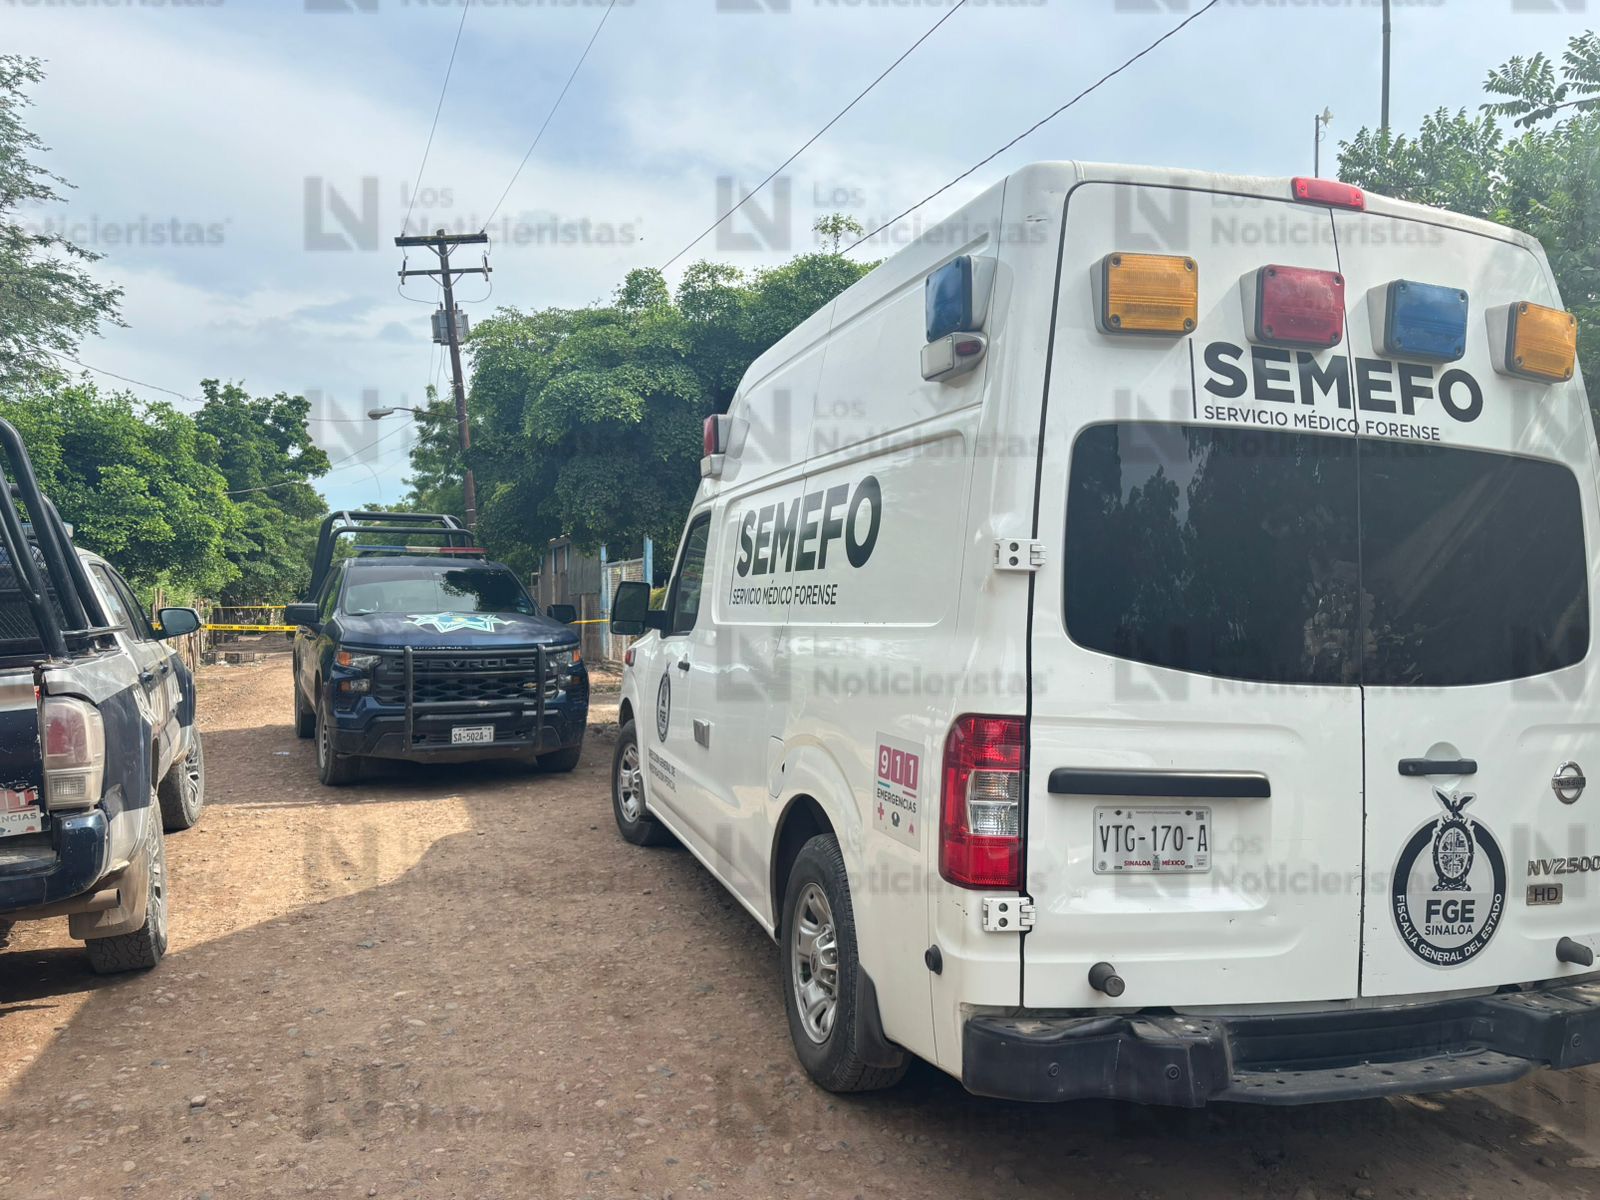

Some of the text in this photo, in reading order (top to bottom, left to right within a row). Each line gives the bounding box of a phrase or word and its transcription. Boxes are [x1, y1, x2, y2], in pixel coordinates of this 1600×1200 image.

[1203, 341, 1483, 423] SEMEFO
[1204, 405, 1441, 441] SERVICIO MÉDICO FORENSE
[736, 474, 882, 578] SEMEFO
[732, 579, 838, 606] SERVICIO MÉDICO FORENSE
[880, 749, 914, 785] 911
[877, 787, 917, 814] EMERGENCIAS
[1099, 824, 1208, 853] VTG-170-A
[1124, 857, 1186, 867] SINALOA MÉXICO
[1527, 855, 1600, 877] NV2500
[1534, 887, 1559, 902] HD
[1425, 899, 1475, 924] FGE
[1396, 893, 1502, 962] FISCALÍA GENERAL DEL ESTADO
[1424, 924, 1473, 936] SINALOA
